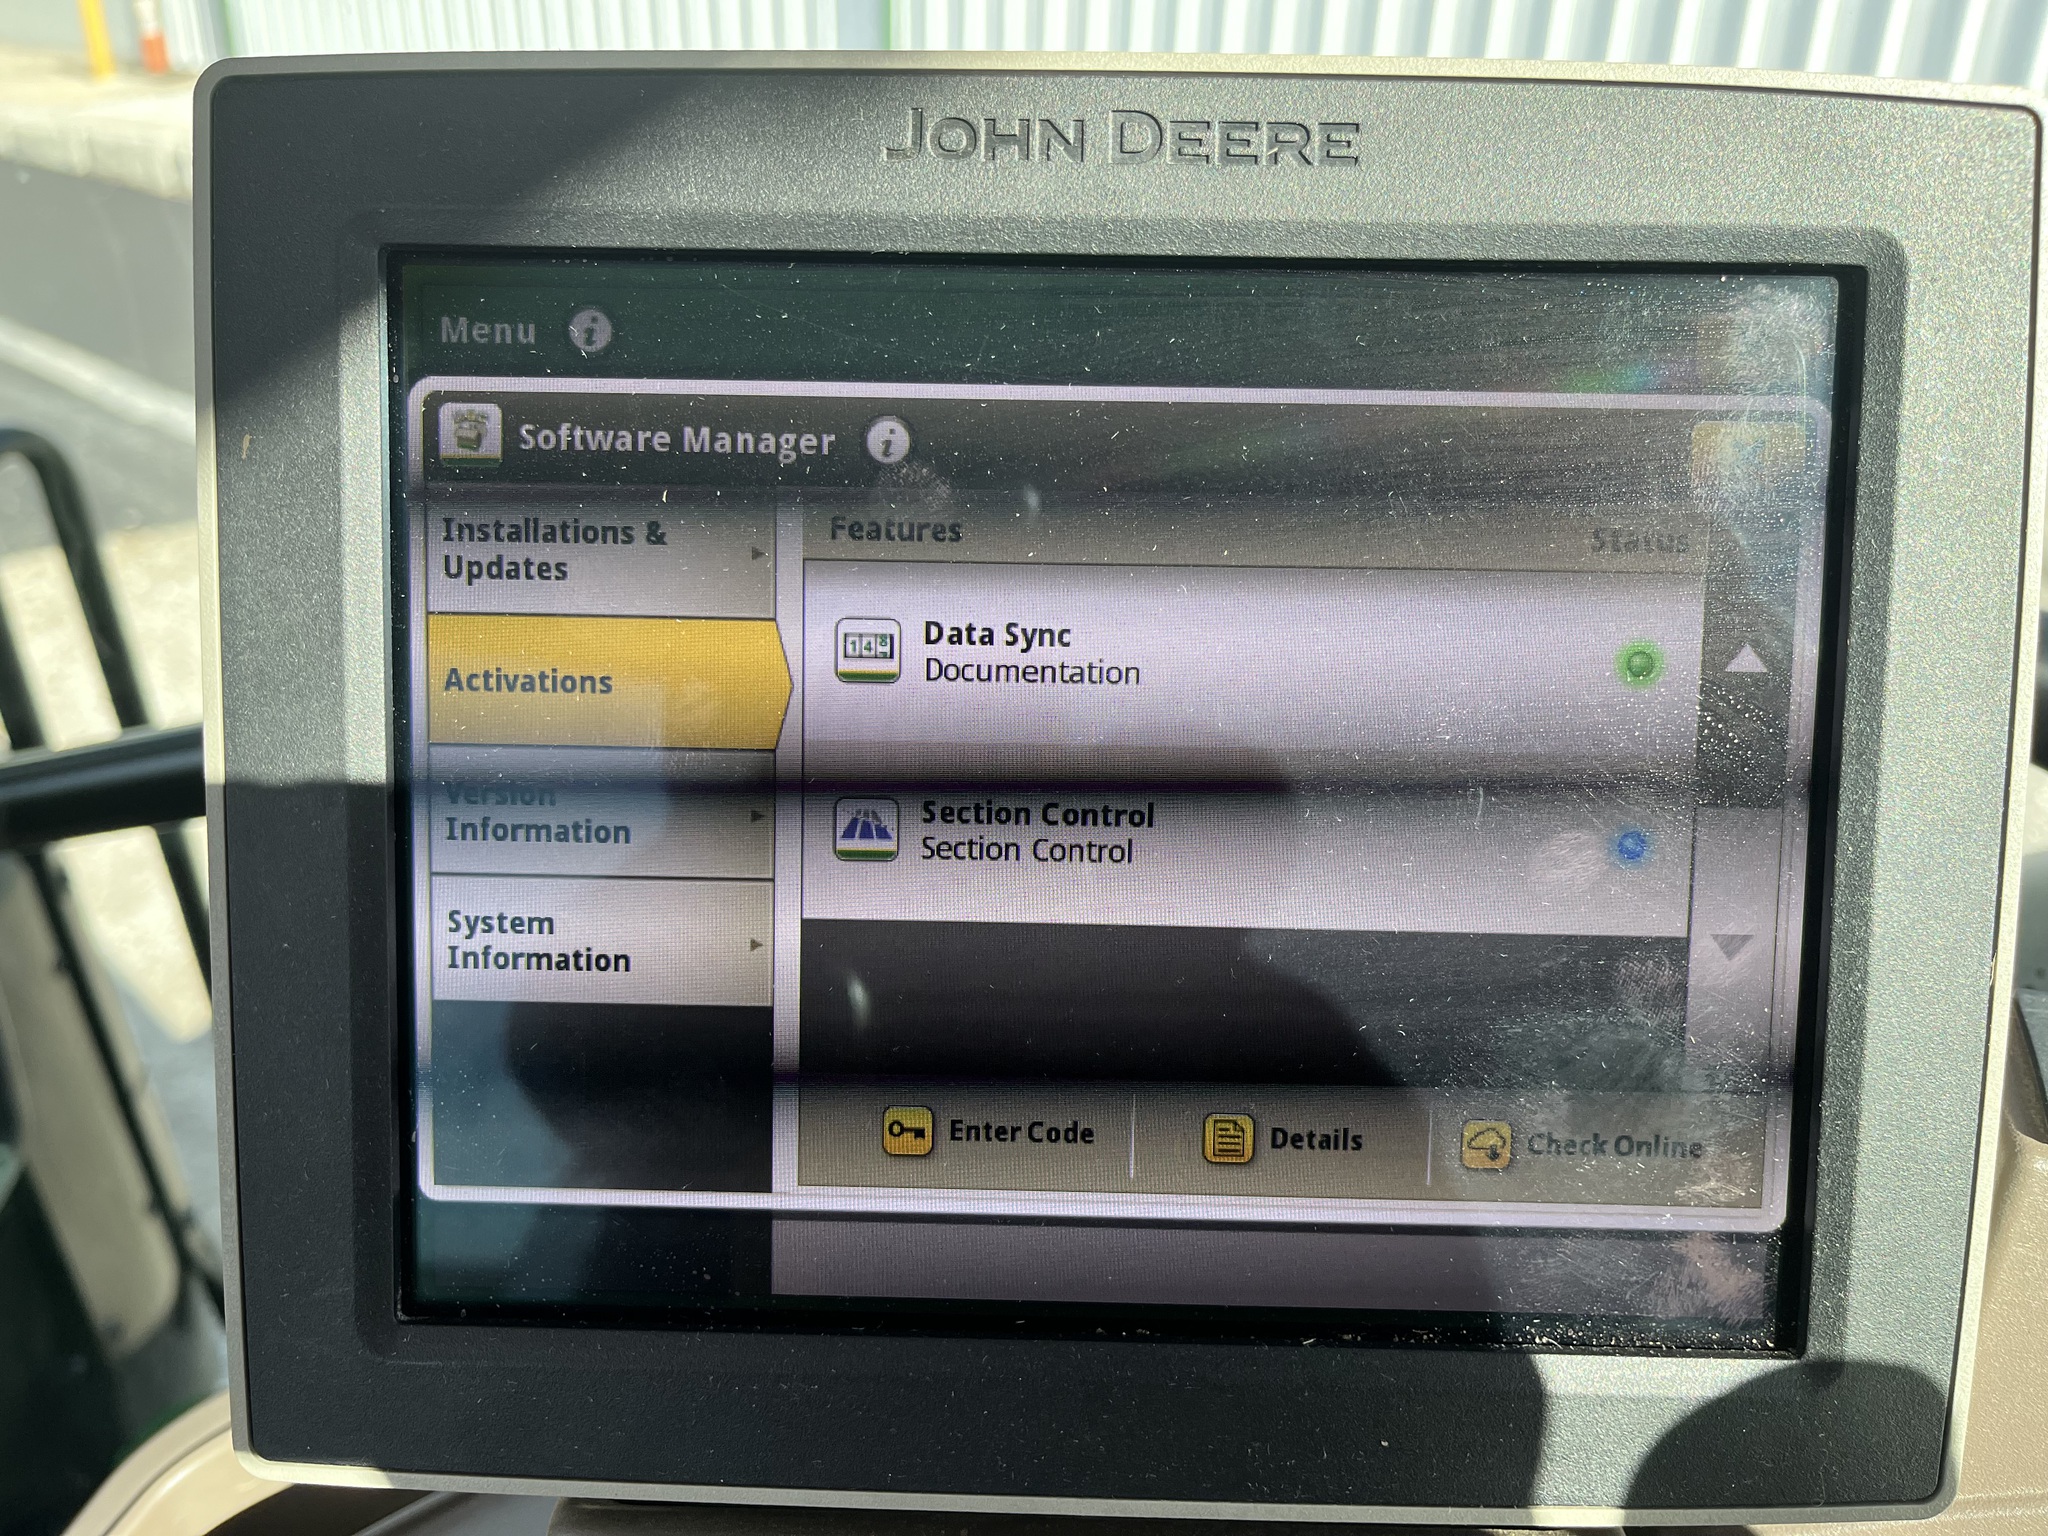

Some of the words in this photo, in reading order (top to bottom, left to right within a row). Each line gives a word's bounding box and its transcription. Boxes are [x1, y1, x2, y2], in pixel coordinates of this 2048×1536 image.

[884, 107, 1085, 163] JOHN
[1109, 109, 1360, 166] DEERE
[441, 316, 536, 345] Menu
[519, 423, 671, 452] Software
[683, 426, 836, 464] Manager
[443, 518, 635, 545] Installations
[646, 521, 667, 545] &
[830, 516, 962, 543] Features
[1591, 527, 1690, 553] Status
[444, 555, 568, 585] Updates
[925, 620, 995, 646] Data
[1005, 622, 1071, 653] Sync
[444, 668, 613, 695] Activations
[925, 657, 1140, 685] Documentation
[447, 783, 558, 807] Version
[922, 800, 1031, 826] Section
[1041, 802, 1155, 828] Control
[446, 816, 632, 844] Information
[922, 836, 1020, 861] Section
[1033, 838, 1133, 864] Control
[448, 909, 555, 937] System
[447, 946, 631, 974] Information
[949, 1119, 1021, 1142] Enter
[1027, 1121, 1095, 1144] Code
[1271, 1127, 1363, 1151] Details
[1527, 1131, 1607, 1156] Check
[1614, 1133, 1703, 1159] Online
